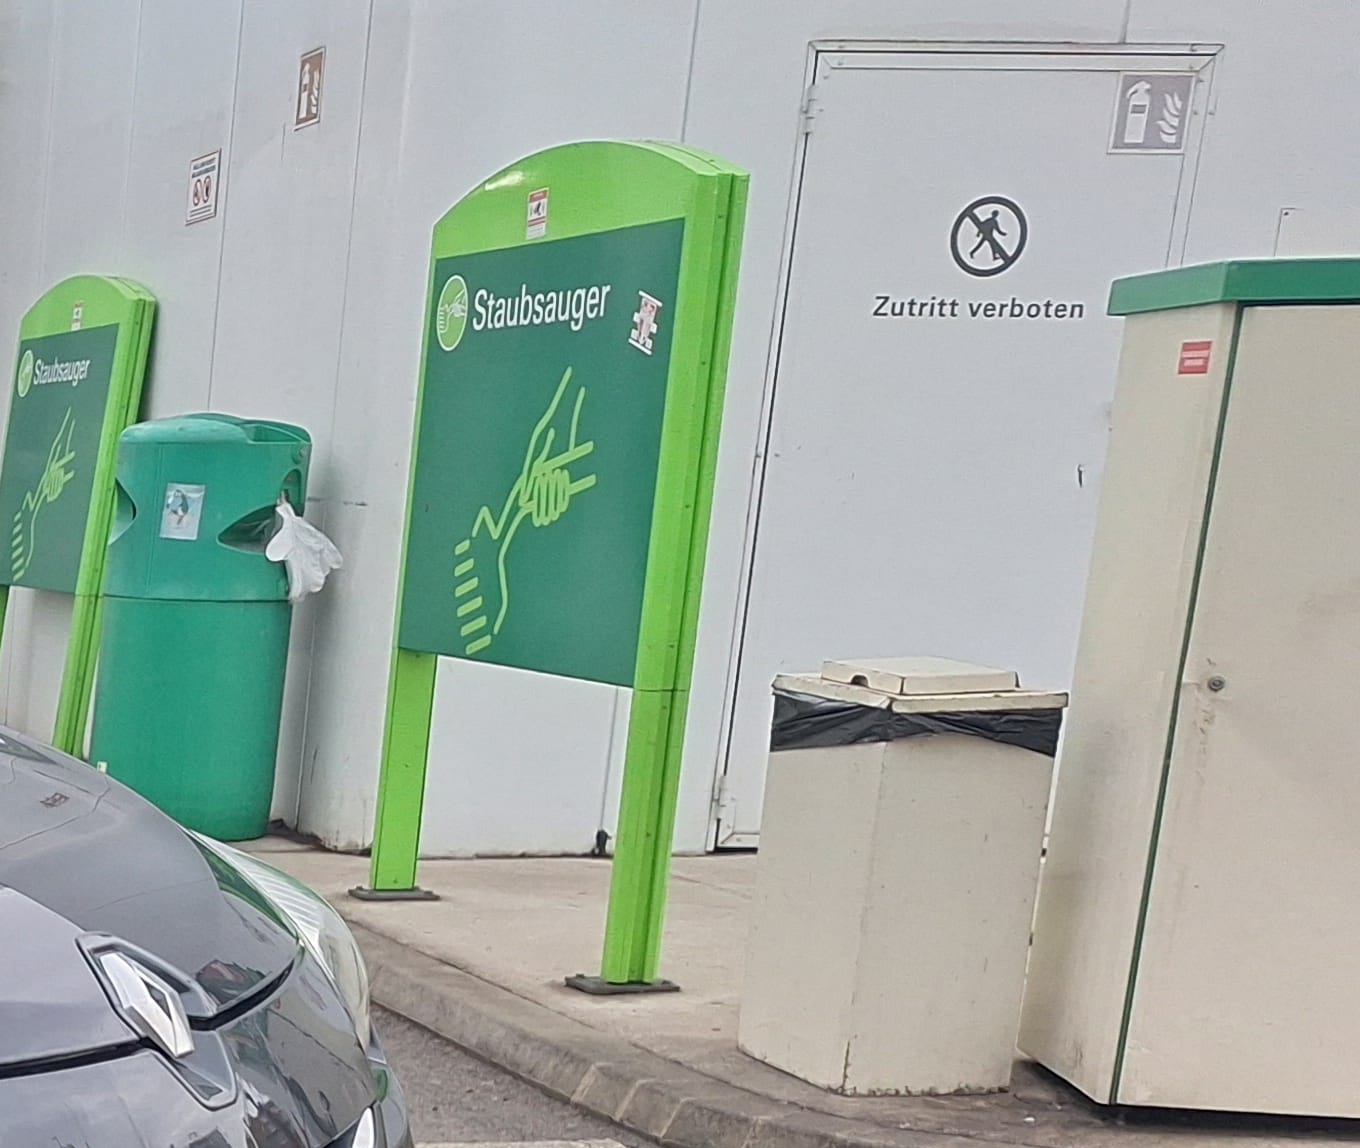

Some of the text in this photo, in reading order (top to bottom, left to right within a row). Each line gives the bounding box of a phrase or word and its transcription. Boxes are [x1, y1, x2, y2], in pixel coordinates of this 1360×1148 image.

[472, 284, 611, 331] Staubsauger
[873, 296, 1084, 318] Zutritt verboten
[33, 356, 91, 387] Staubsauger
